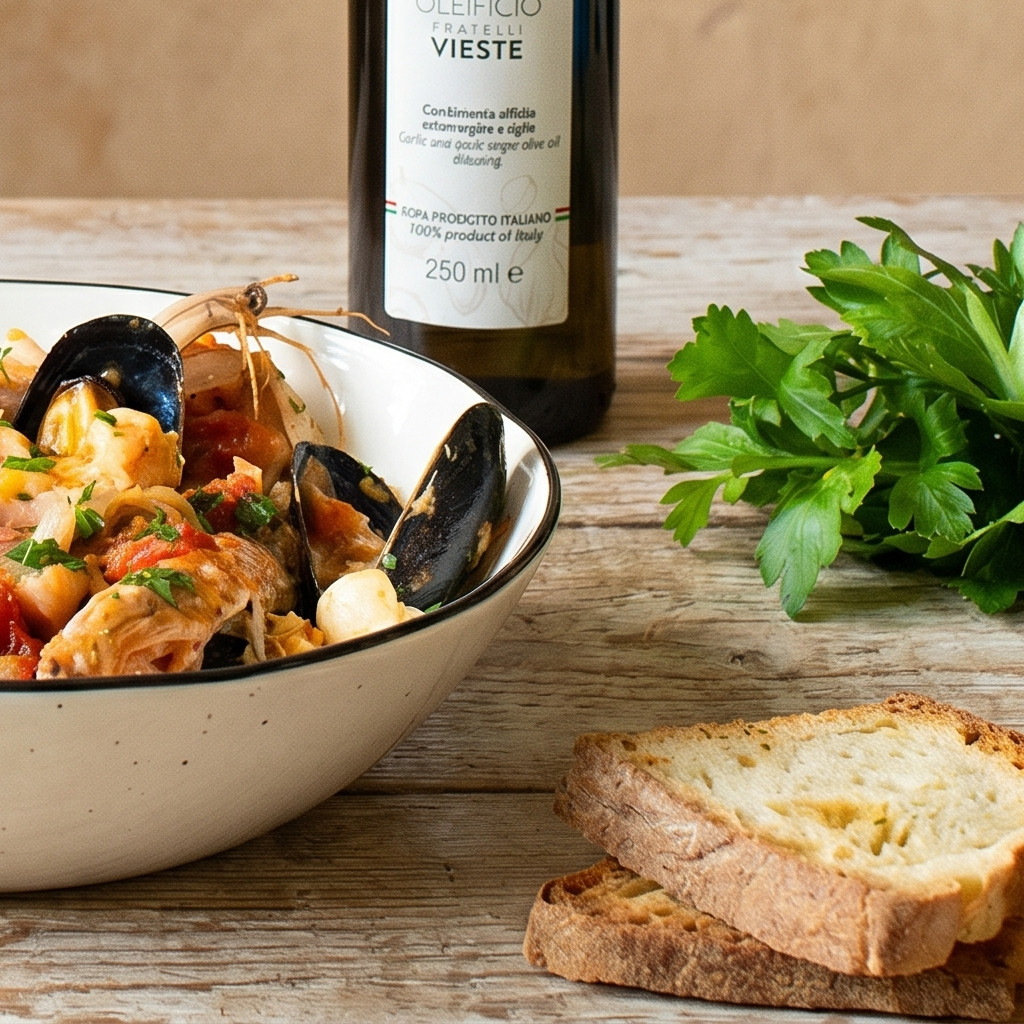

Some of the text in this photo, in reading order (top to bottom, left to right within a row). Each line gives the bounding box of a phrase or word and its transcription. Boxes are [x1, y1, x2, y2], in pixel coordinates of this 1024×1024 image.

[432, 21, 523, 36] FRATELLI
[431, 36, 523, 60] VIESTE
[444, 228, 495, 243] product
[498, 228, 512, 243] of
[425, 257, 467, 283] 250
[473, 261, 499, 284] ml
